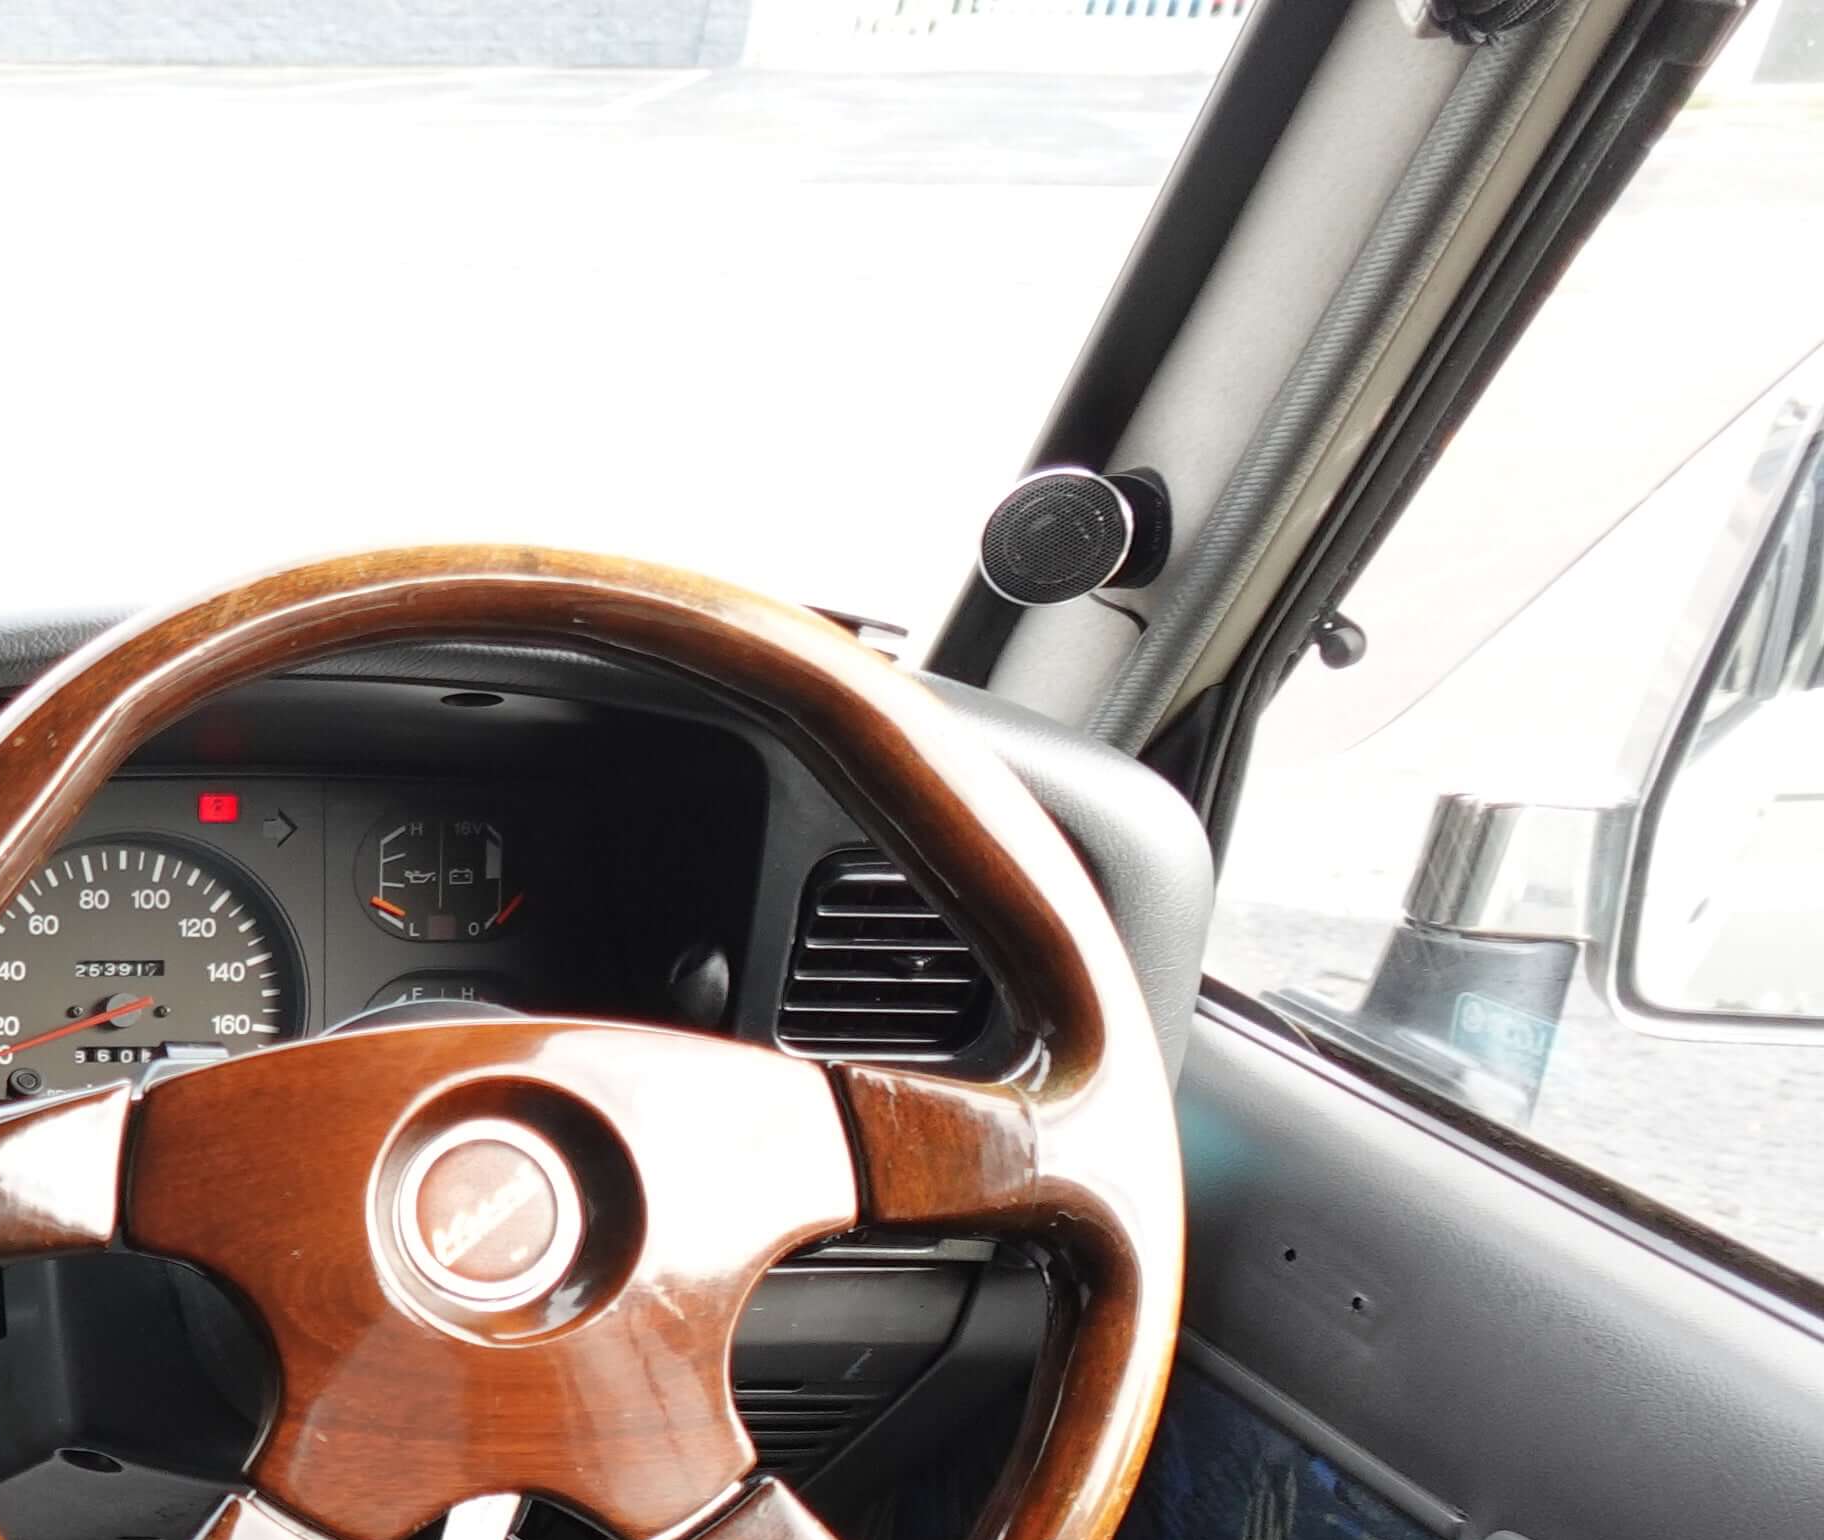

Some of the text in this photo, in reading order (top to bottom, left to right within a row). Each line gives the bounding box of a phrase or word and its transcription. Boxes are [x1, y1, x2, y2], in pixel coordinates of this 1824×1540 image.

[79, 889, 110, 910] 80
[131, 889, 171, 910] 100
[28, 915, 59, 936] 60
[178, 917, 217, 938] 120
[206, 962, 246, 983] 140
[211, 1014, 251, 1035] 160
